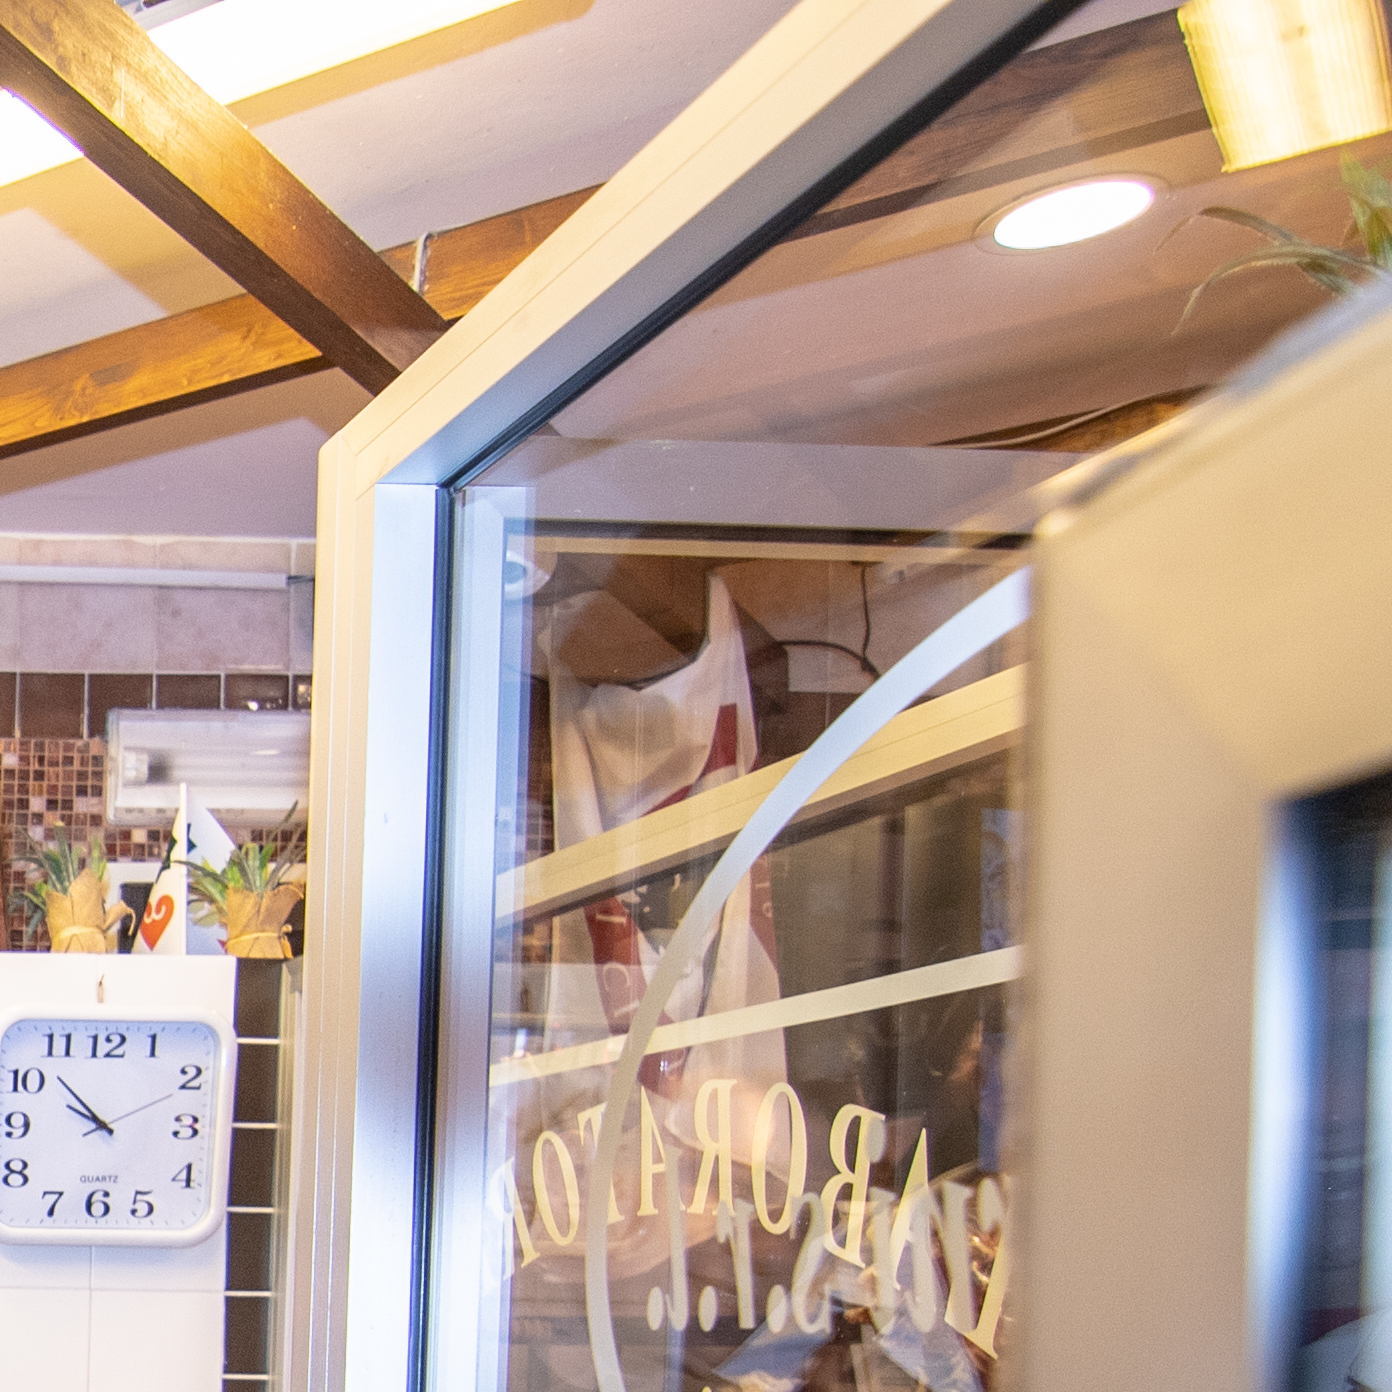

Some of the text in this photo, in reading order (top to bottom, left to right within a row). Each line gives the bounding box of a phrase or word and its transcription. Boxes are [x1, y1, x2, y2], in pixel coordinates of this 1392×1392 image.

[41, 1032, 75, 1058] 11
[85, 1032, 127, 1059] 12
[145, 1033, 159, 1059] 1
[6, 1067, 45, 1094] 10
[178, 1064, 203, 1090] 2
[4, 1111, 31, 1139] 9
[172, 1114, 200, 1140] 3
[2, 1158, 29, 1188] 8
[79, 1175, 119, 1184] QUARTZ
[171, 1162, 195, 1189] 4
[41, 1191, 64, 1217] 7
[84, 1189, 111, 1218] 6
[130, 1190, 155, 1218] 5
